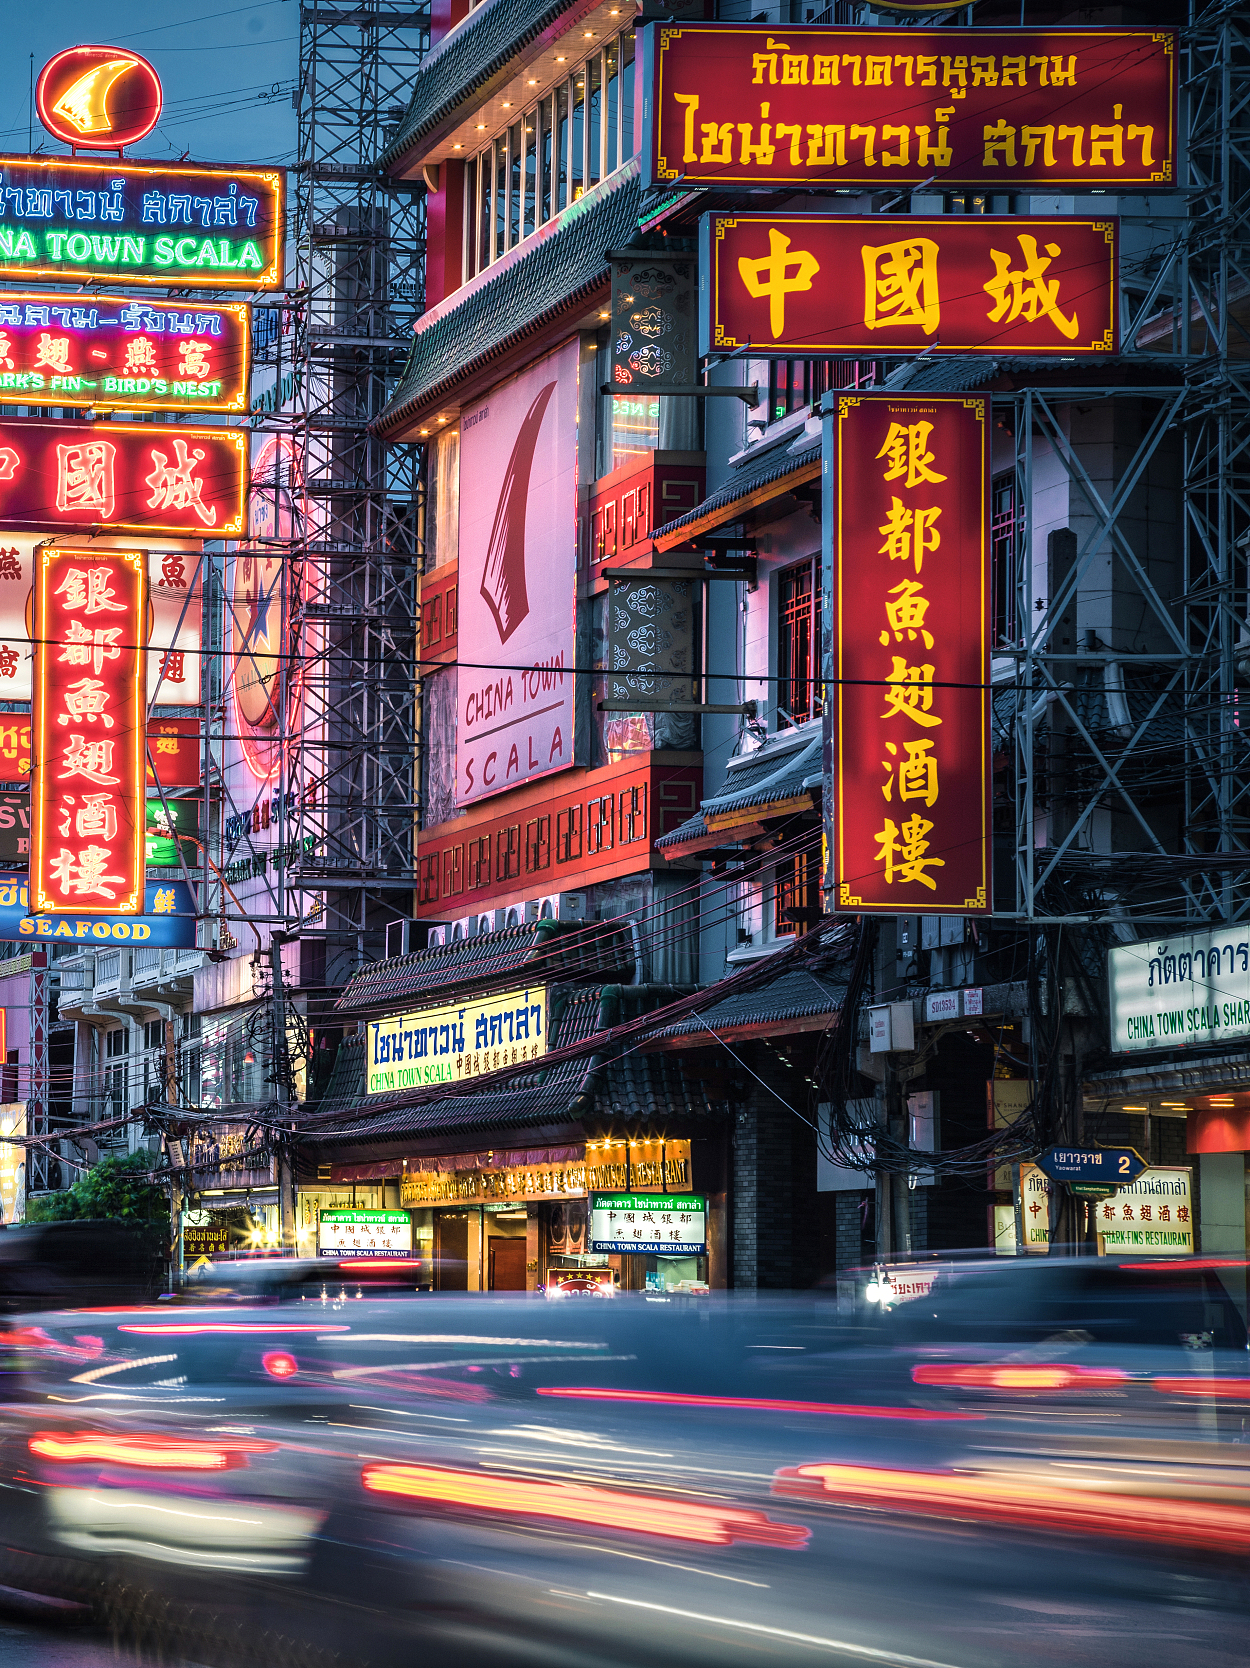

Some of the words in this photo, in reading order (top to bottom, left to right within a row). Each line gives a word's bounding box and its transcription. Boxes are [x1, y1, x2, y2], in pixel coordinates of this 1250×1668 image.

[752, 38, 1077, 100] ภัตตาคารหูฉลาม
[674, 92, 954, 167] ไชน่าทาวน์
[982, 103, 1155, 167] สกาล่า
[142, 182, 259, 227] สกาล่า
[47, 232, 145, 264] TOWN
[154, 238, 263, 269] SCALA
[737, 227, 1080, 340] 中國城
[104, 377, 168, 395] BIRD'S
[172, 380, 222, 397] NEST
[872, 420, 948, 891] 銀都魚翅酒樓
[465, 682, 513, 727] CHINA
[522, 649, 565, 700] TOWN
[49, 565, 129, 900] 銀都魚翅酒樓
[464, 726, 564, 795] SCALA
[19, 918, 151, 940] SEAFOOD
[1148, 942, 1249, 987] ภัตตาคาร
[372, 1007, 466, 1065] ไชน่าทาวน์
[475, 990, 542, 1050] สกาล่า
[1128, 1014, 1155, 1039] CHINA
[1157, 1010, 1184, 1036] TOWN
[1187, 1004, 1220, 1031] SCALA
[370, 1070, 395, 1092] CHINA
[397, 1066, 422, 1087] TOWN
[424, 1062, 452, 1084] SCALA
[1054, 1152, 1102, 1165] เยาวราช
[1118, 1156, 1130, 1174] 2
[596, 1197, 632, 1208] ภัตตาคาร
[633, 1197, 673, 1209] ไชน่าทาวน์
[676, 1200, 701, 1210] สกาล่า
[607, 1211, 692, 1224] 中國城銀都
[1096, 1202, 1190, 1222] 都魚翅酒樓
[613, 1229, 682, 1242] 魚翅酒樓
[660, 1244, 701, 1252] RESTAURANT
[1030, 1228, 1049, 1242] CHIN
[1146, 1232, 1191, 1246] RESTAURANT
